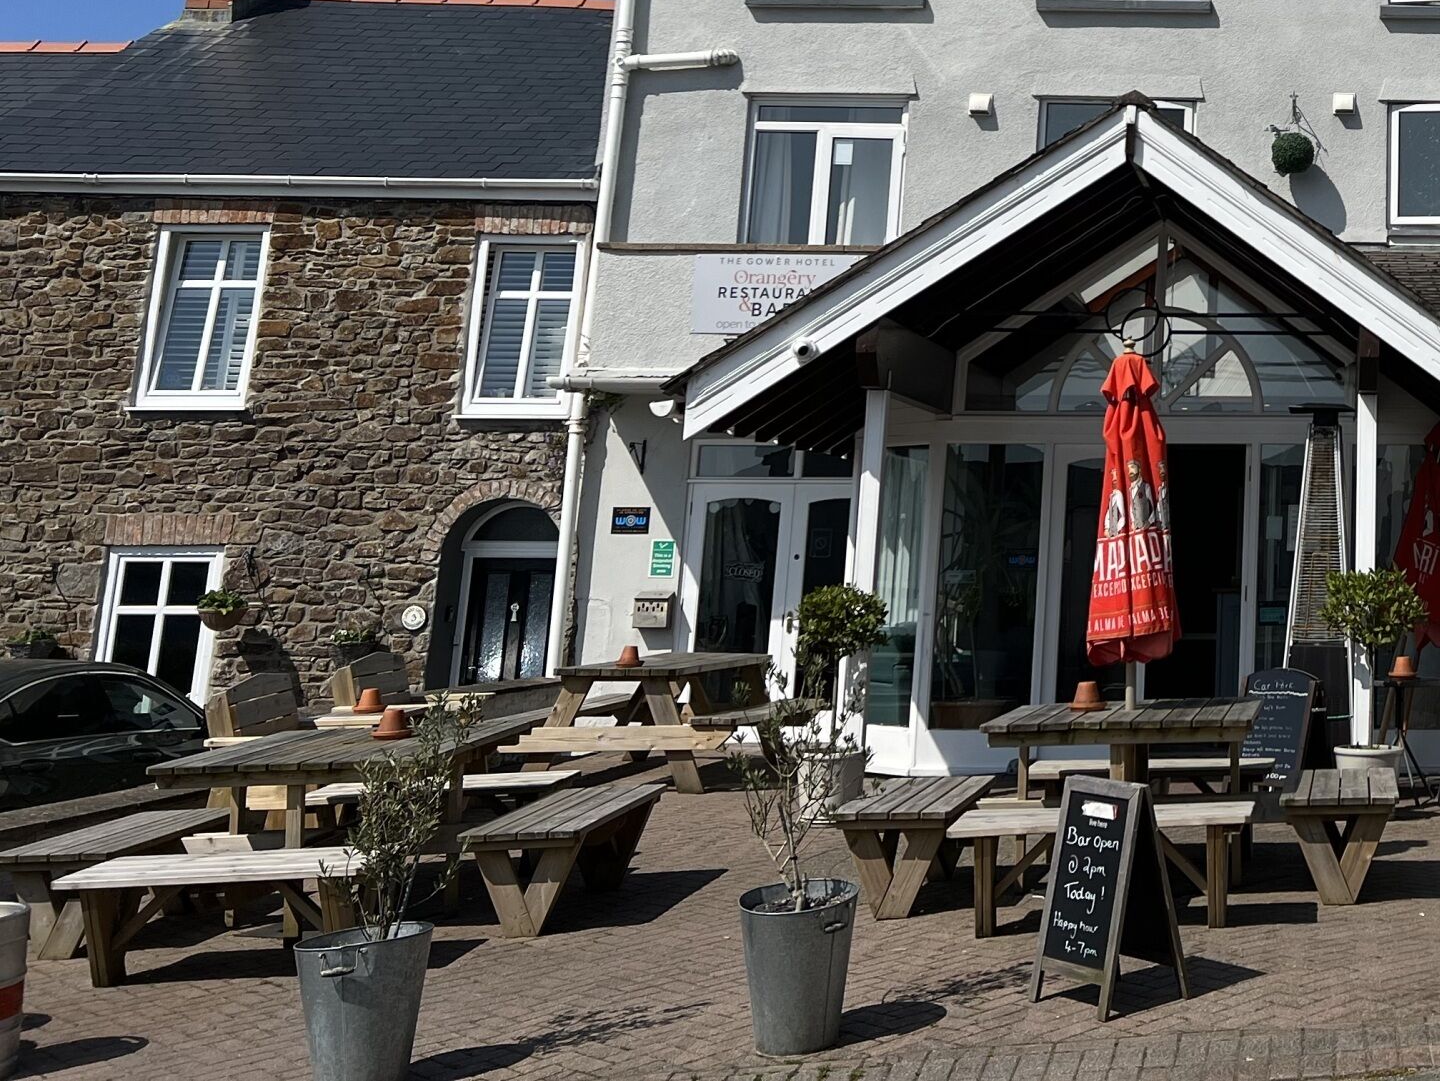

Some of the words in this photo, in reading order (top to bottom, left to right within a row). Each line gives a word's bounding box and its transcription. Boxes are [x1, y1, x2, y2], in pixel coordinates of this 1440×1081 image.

[720, 257, 742, 265] THE
[746, 257, 791, 266] GOWER
[796, 258, 836, 267] HOTEL
[718, 287, 814, 299] RESTAURA
[715, 321, 743, 331] open
[1066, 826, 1091, 847] Bar
[1093, 835, 1119, 853] Open
[1068, 854, 1078, 874] @
[1082, 856, 1106, 880] 2pm
[1064, 881, 1096, 915] Today
[1053, 910, 1078, 939] Happy
[1079, 921, 1099, 933] hour
